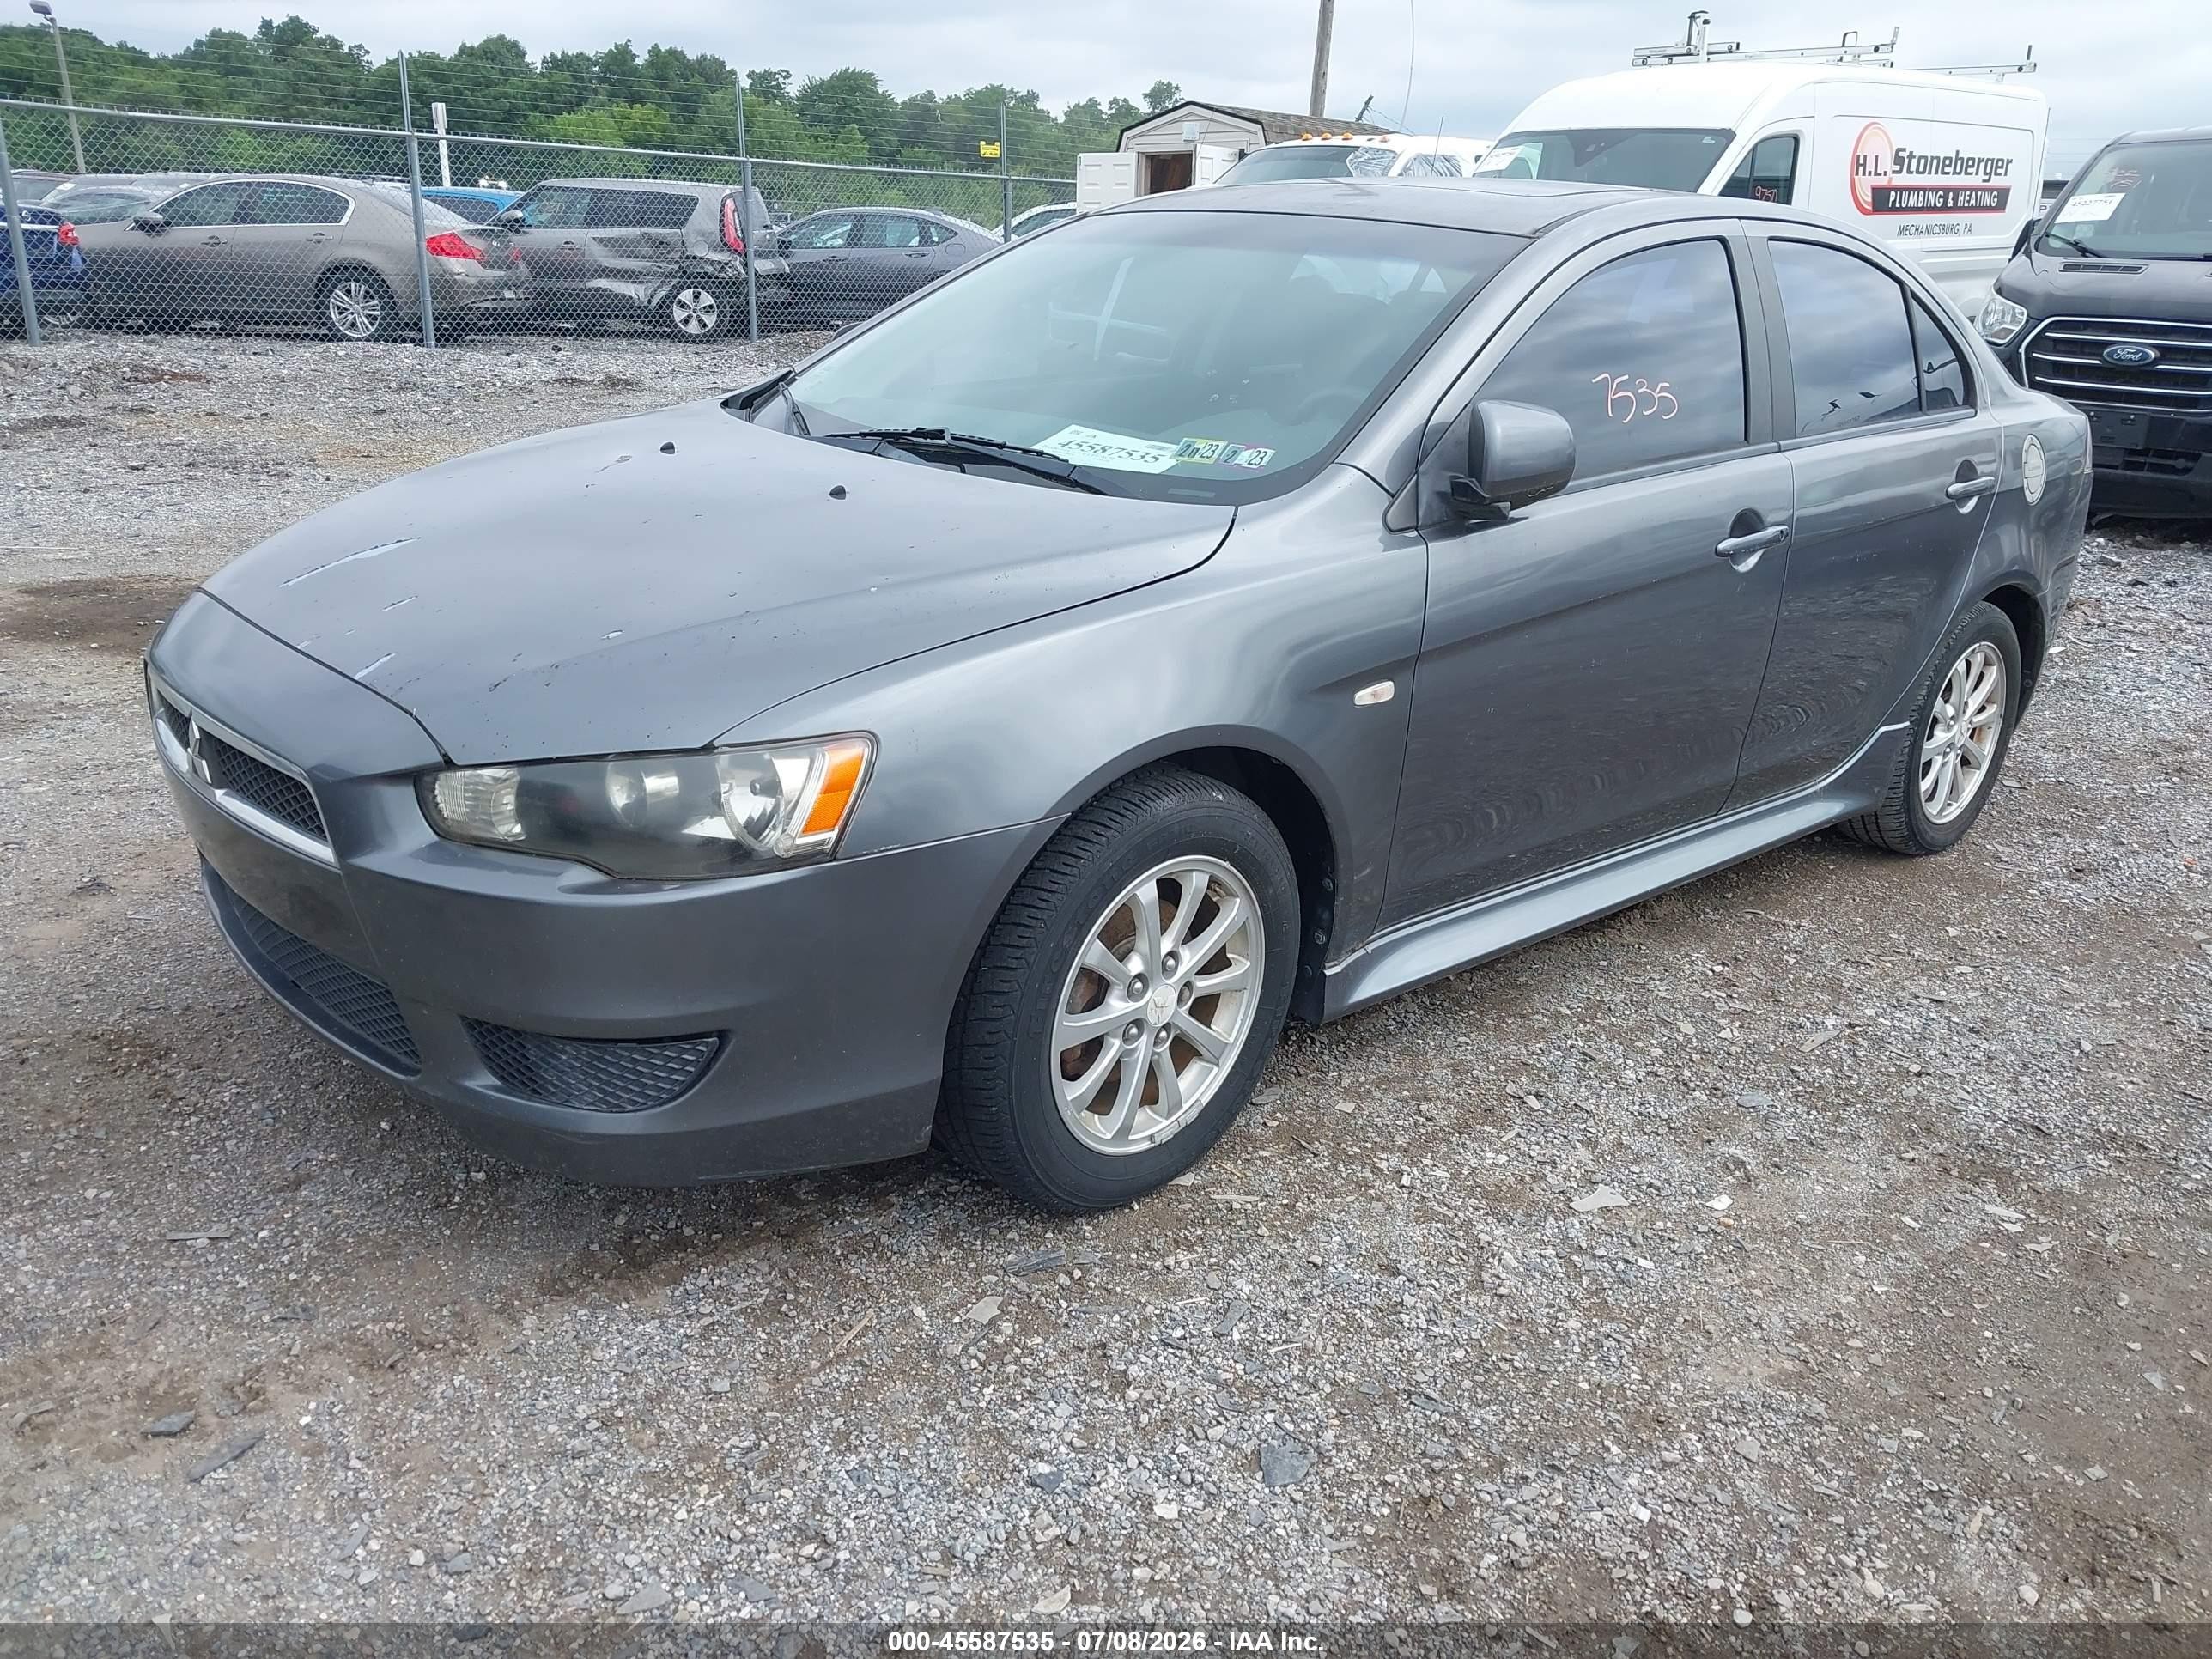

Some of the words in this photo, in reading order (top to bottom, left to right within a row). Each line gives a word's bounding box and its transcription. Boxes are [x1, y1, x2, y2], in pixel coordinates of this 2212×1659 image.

[1855, 154, 1887, 177] H.L.
[1892, 148, 2014, 183] Stoneberger
[1888, 191, 1944, 208] PLUMBING
[1947, 191, 1954, 207] &
[1957, 191, 1998, 207] HEATING
[1896, 223, 1961, 237] MECHANICSBURG,
[1963, 223, 1972, 234] PA
[2112, 348, 2143, 361] Ford
[1591, 373, 1679, 423] 7535
[1057, 440, 1162, 464] 45587535
[1248, 449, 1268, 466] 23
